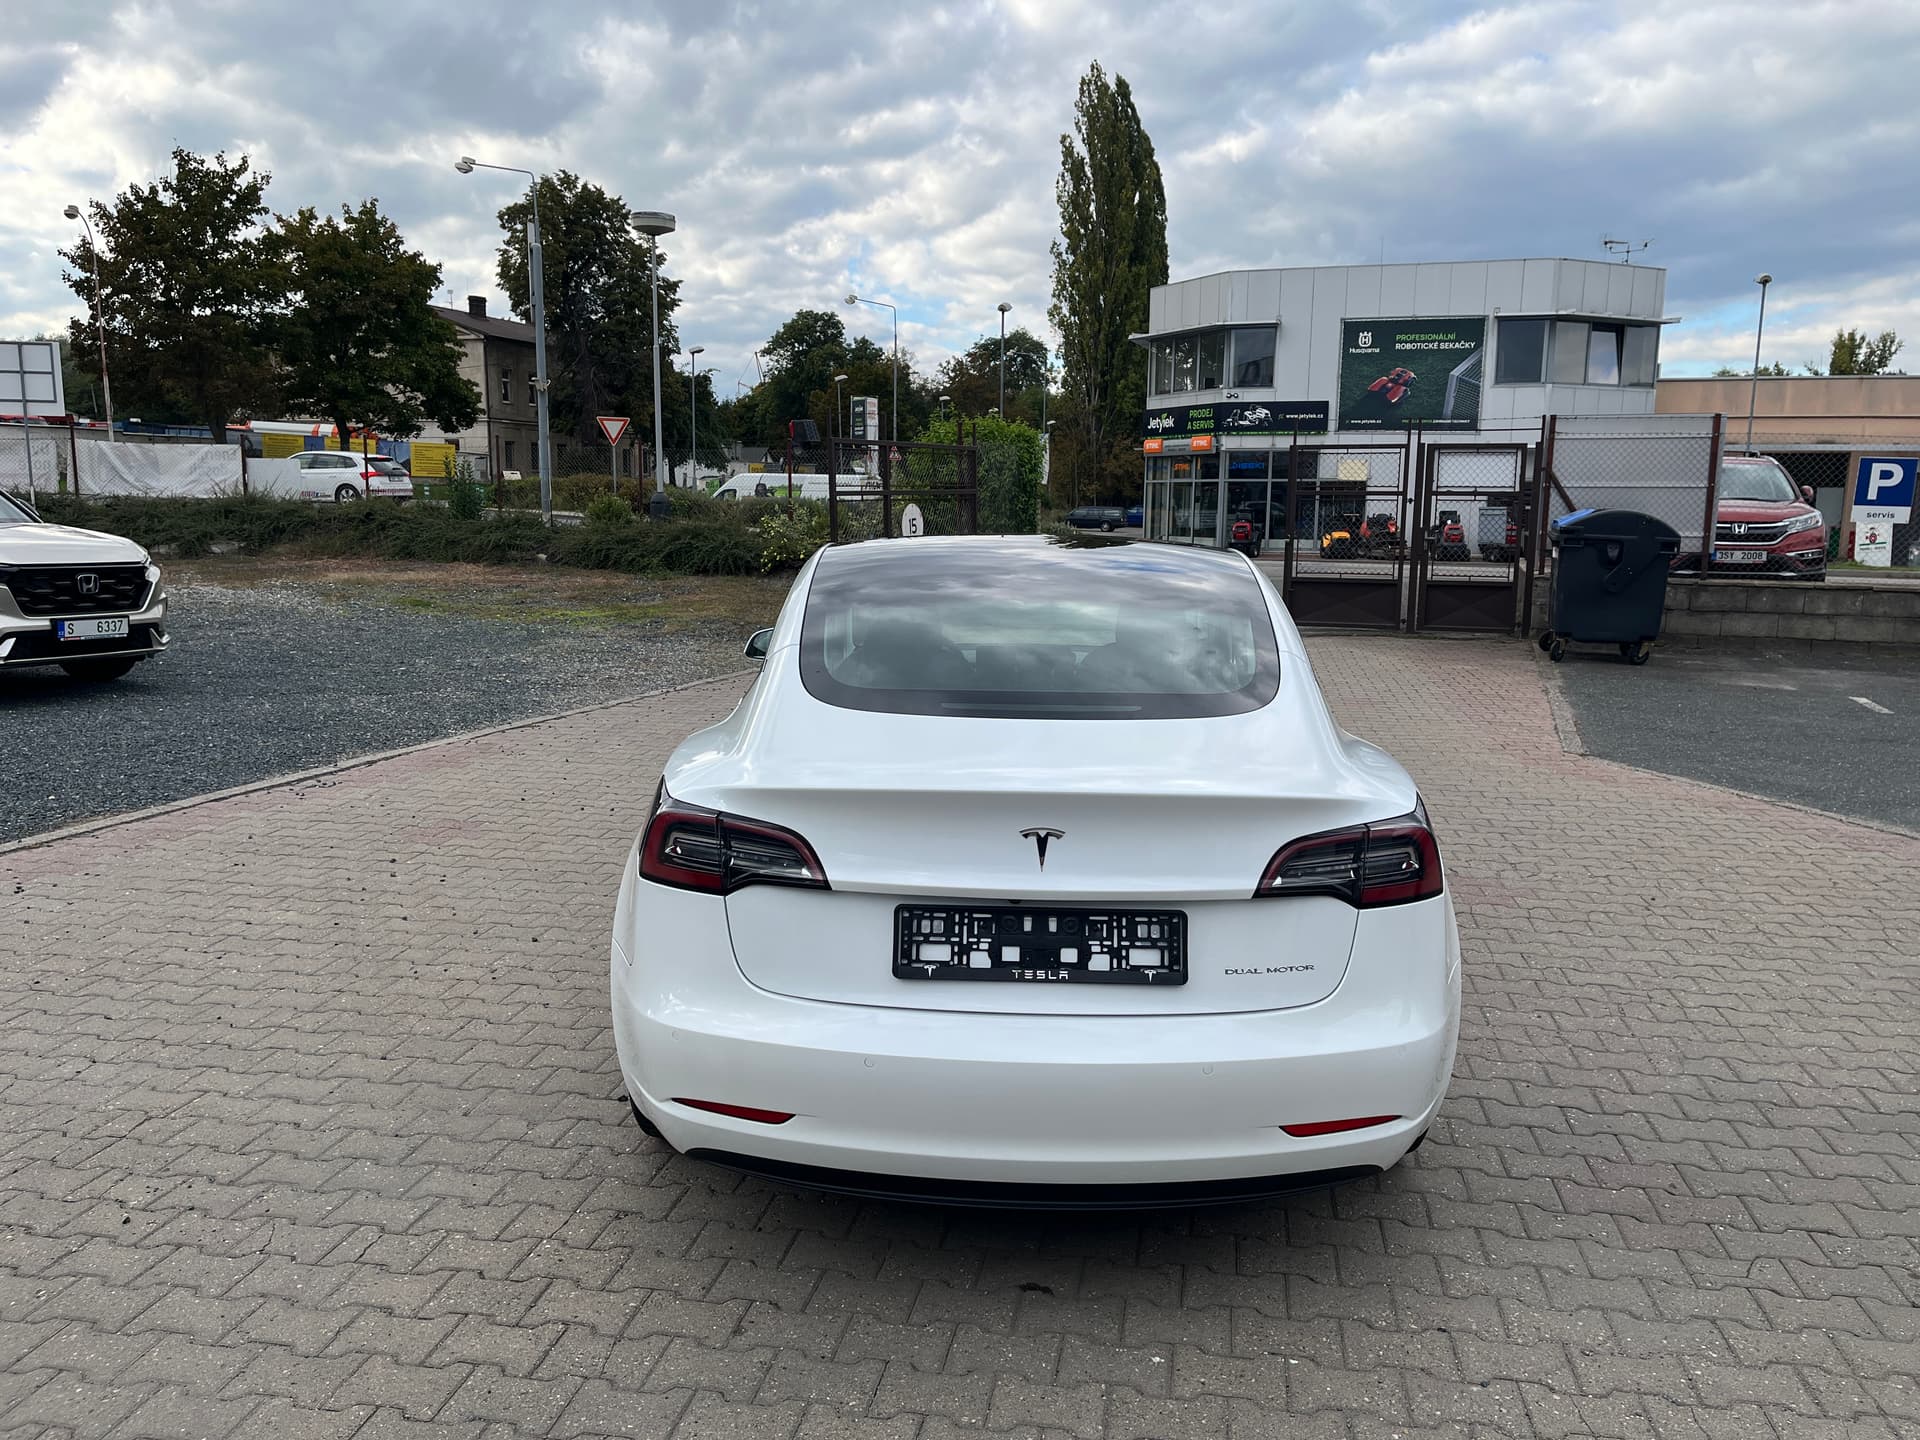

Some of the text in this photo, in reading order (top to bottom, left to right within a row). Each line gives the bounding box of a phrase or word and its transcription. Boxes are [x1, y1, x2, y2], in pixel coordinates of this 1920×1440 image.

[1396, 332, 1456, 341] PROFESIONÁLNÍ
[1395, 340, 1476, 350] ROBOTICKÉ SEKAČKY
[1189, 408, 1214, 419] PRODEJ
[1147, 415, 1175, 433] Jetylek
[1187, 420, 1215, 430] A SERVIS
[1867, 463, 1905, 501] P
[1866, 511, 1896, 519] servis
[908, 518, 917, 534] 15
[1718, 552, 1763, 560] 3SY 2008
[67, 623, 74, 635] S
[97, 620, 123, 633] 6337
[1266, 964, 1315, 973] MOTOR
[1012, 969, 1069, 980] TESLA
